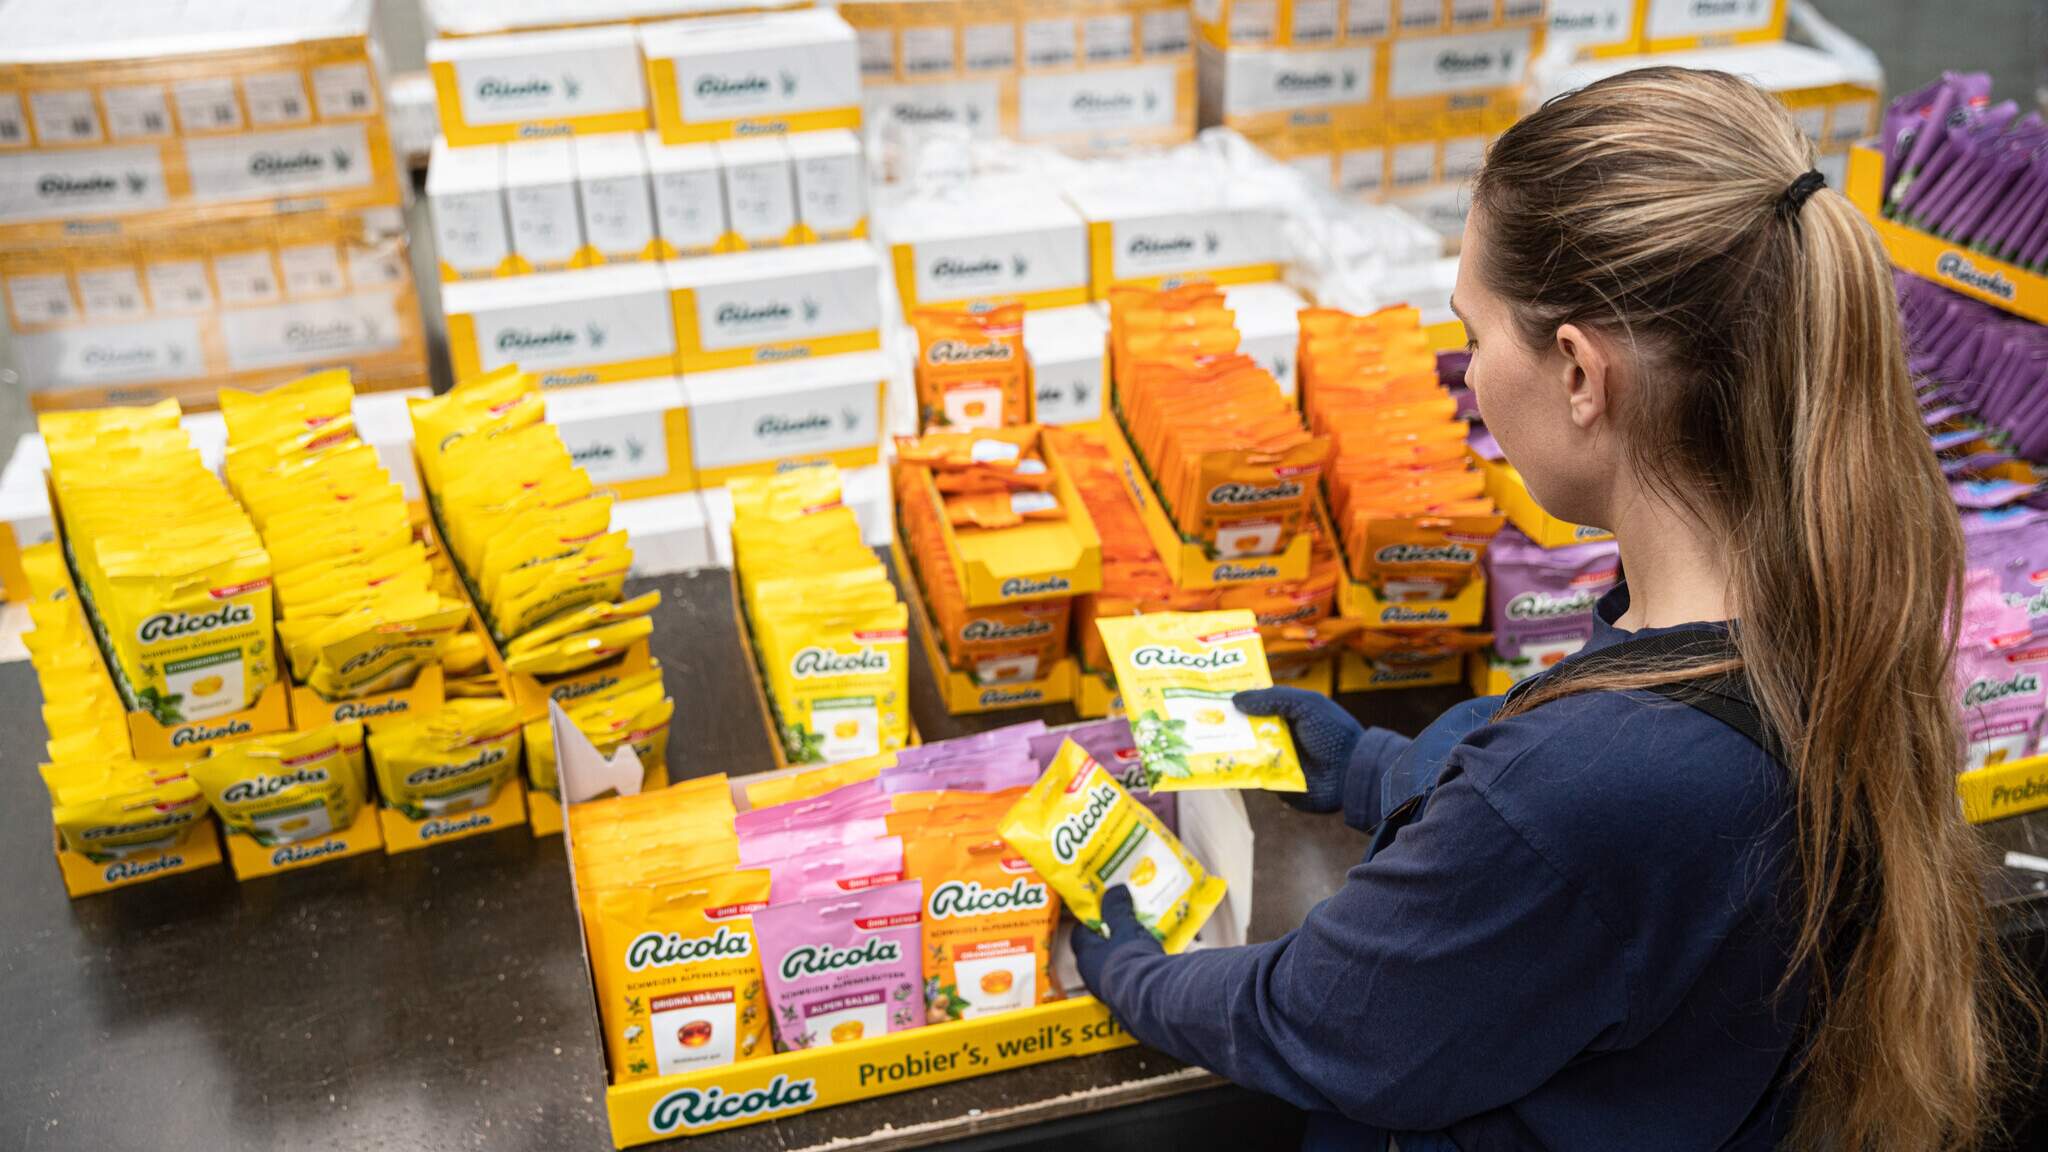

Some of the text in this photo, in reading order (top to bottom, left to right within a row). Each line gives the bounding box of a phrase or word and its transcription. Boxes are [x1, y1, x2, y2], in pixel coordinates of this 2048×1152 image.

[1210, 479, 1302, 504] Ricola
[141, 604, 251, 641] Ricola
[796, 650, 885, 674] Ricola
[1136, 648, 1240, 669] Ricola
[1965, 674, 2037, 705] Ricola
[334, 698, 409, 722] Ricola
[172, 720, 252, 747] Ricola
[223, 768, 328, 802] Ricola
[421, 814, 493, 839] Ricola
[1055, 785, 1116, 860] Ricola
[273, 840, 347, 866] Ricola
[106, 856, 183, 882] Ricola
[932, 881, 1044, 916] Ricola
[629, 928, 748, 968] Ricola
[782, 938, 898, 979] Ricola
[811, 998, 843, 1014] ALPEN
[859, 1043, 990, 1087] Probier's,
[996, 1024, 1073, 1059] weil's
[653, 1077, 814, 1131] Ricola
